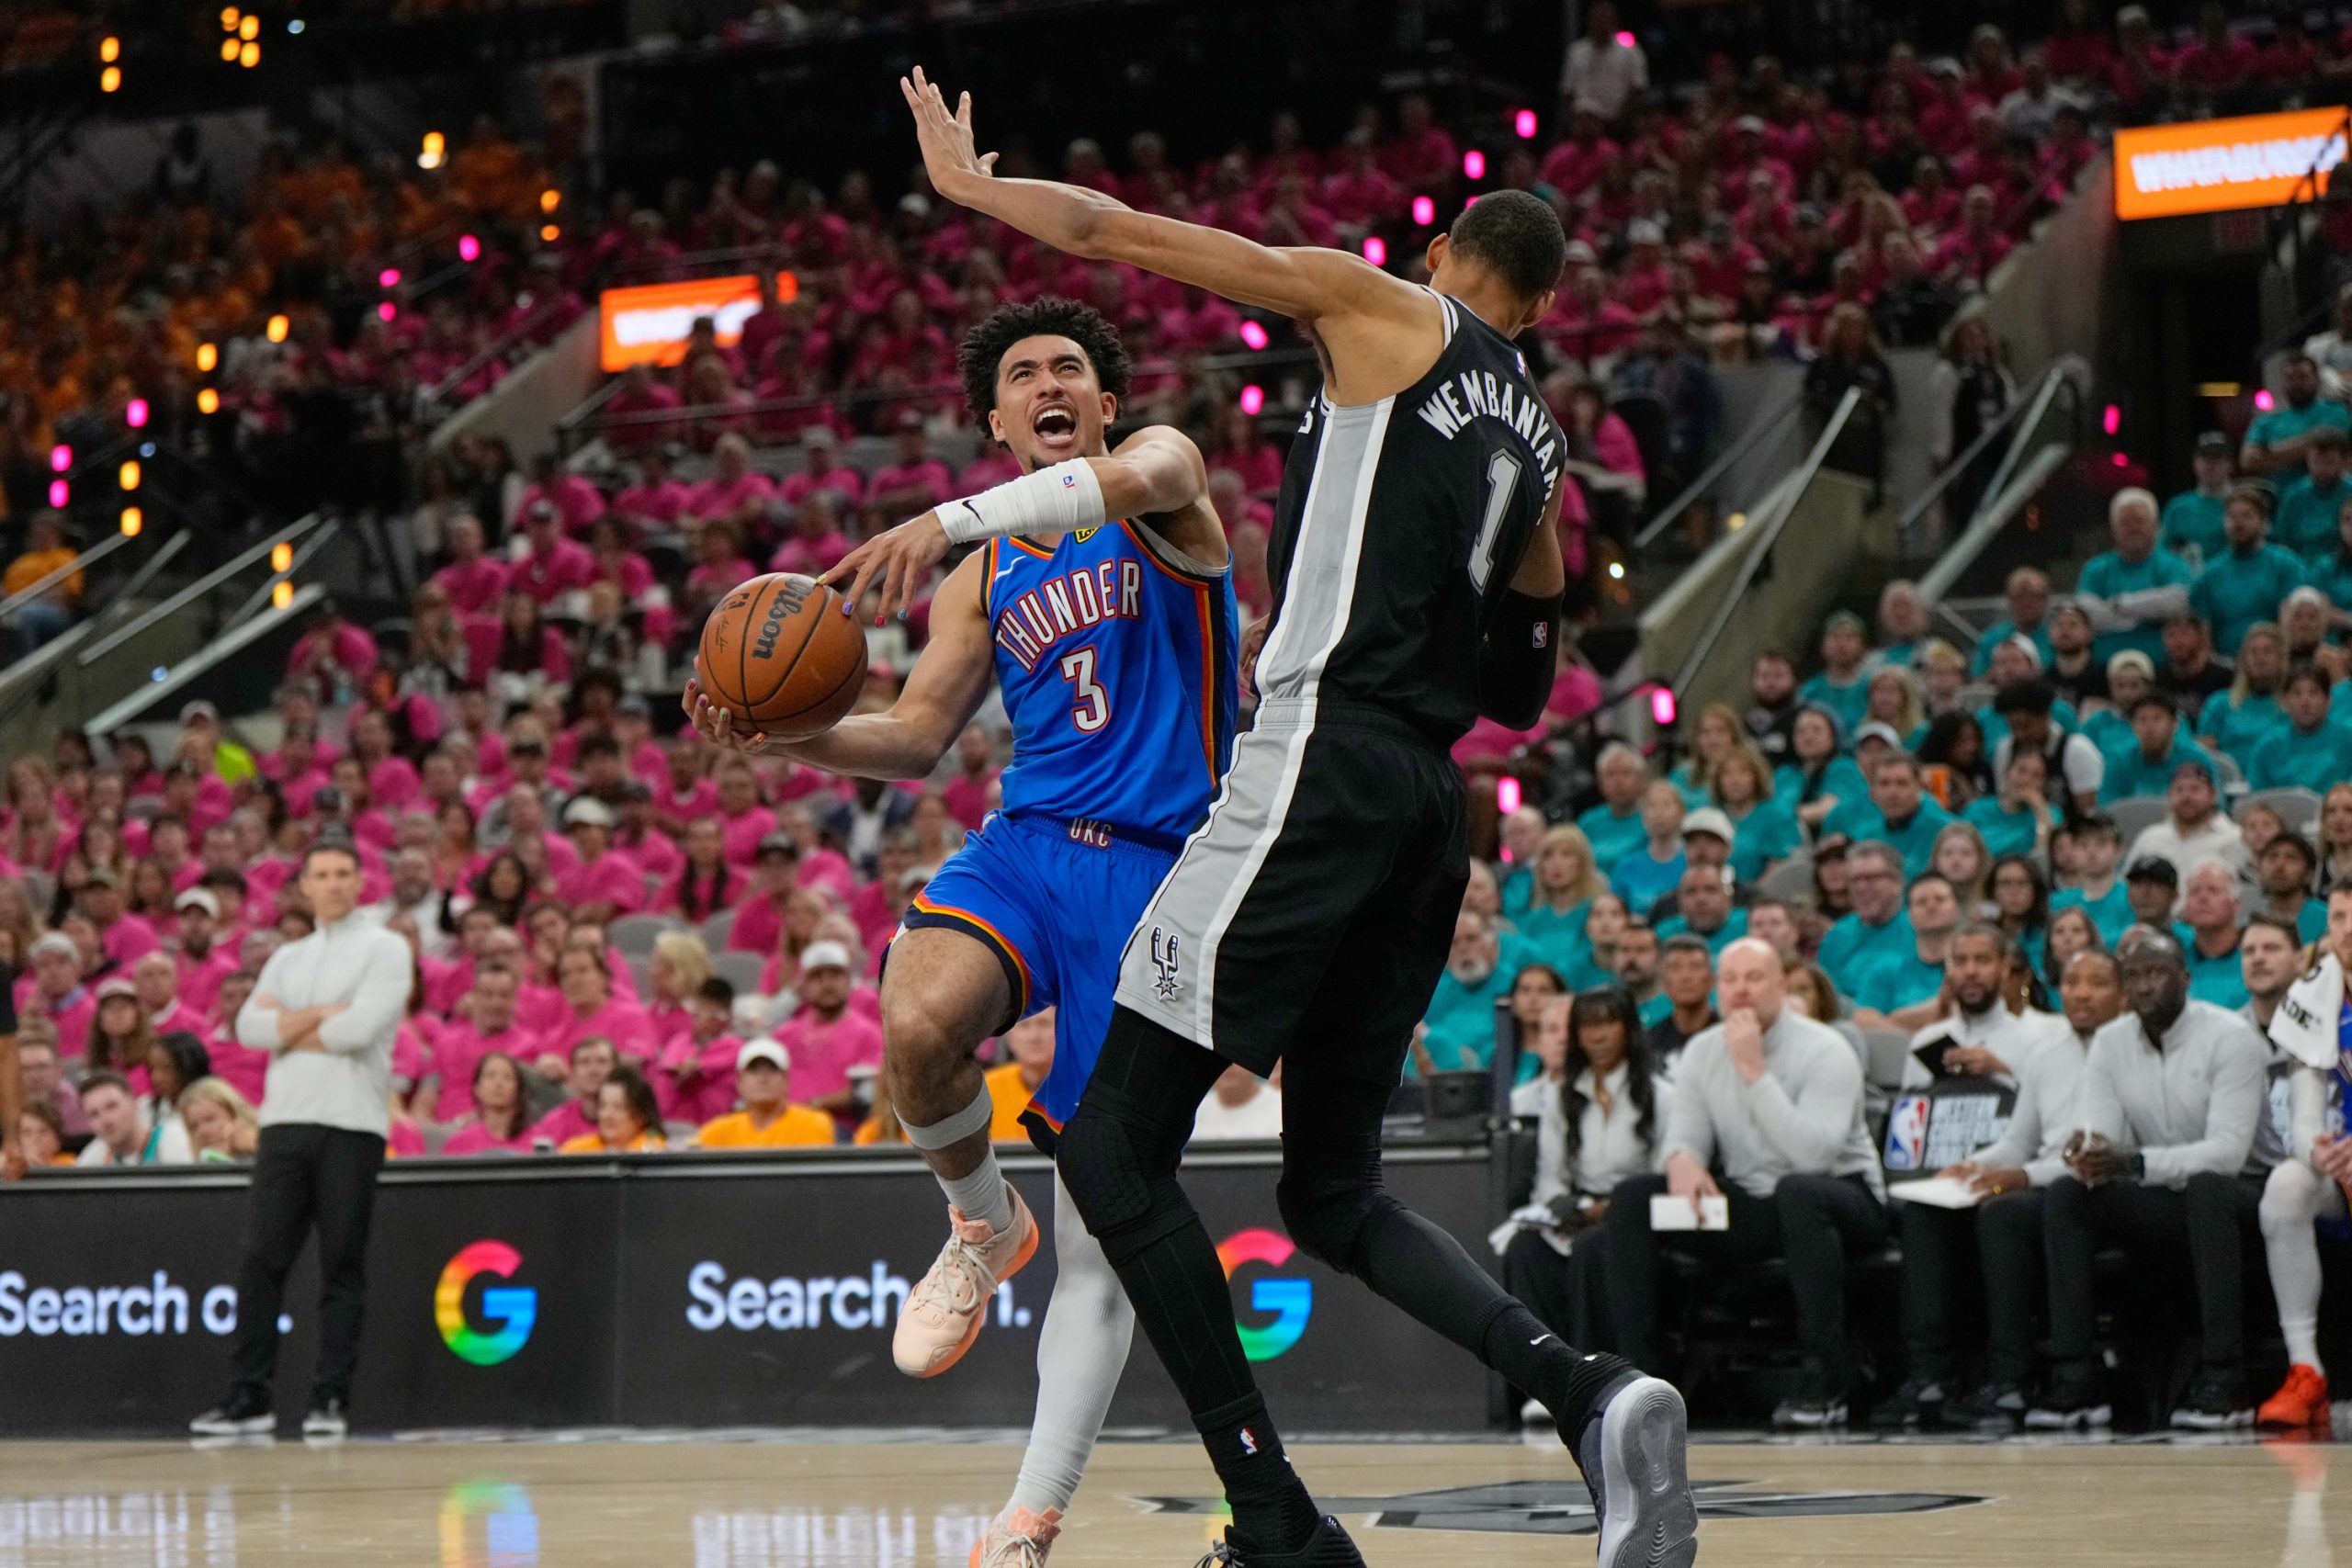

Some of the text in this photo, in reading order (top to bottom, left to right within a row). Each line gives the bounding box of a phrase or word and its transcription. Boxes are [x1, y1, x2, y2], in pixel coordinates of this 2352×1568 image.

[1418, 369, 1559, 525] WEMBANYAM
[1467, 447, 1522, 596] 1
[752, 578, 817, 660] Wilson
[994, 558, 1142, 671] THUNDER
[1058, 647, 1111, 734] 3
[1070, 817, 1112, 848] OKC
[0, 1269, 189, 1335] Search
[434, 1238, 538, 1366] G
[685, 1260, 911, 1331] Search
